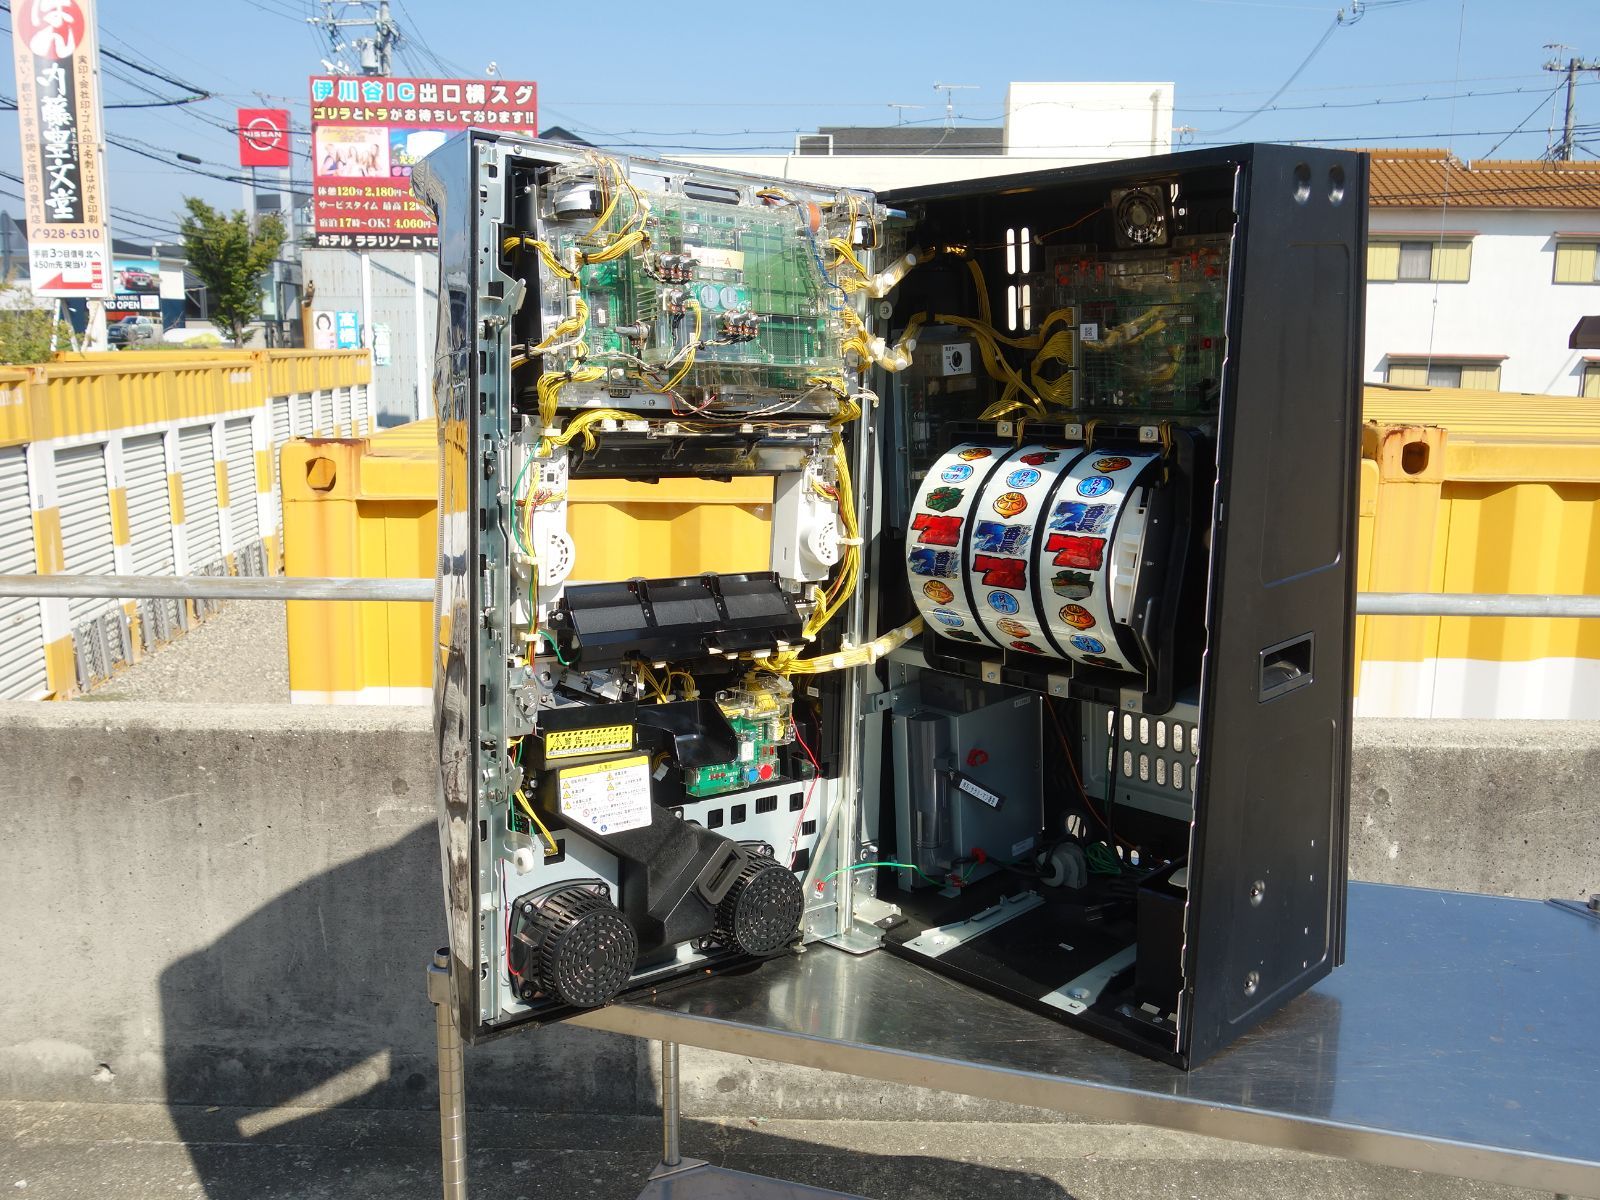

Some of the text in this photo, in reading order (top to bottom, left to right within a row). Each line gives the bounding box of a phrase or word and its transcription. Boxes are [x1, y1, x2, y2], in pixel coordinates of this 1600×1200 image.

[318, 200, 379, 210] サービスタイム
[43, 229, 99, 239] 928-6310
[318, 234, 353, 246] ホテル
[117, 301, 140, 310] OPEN
